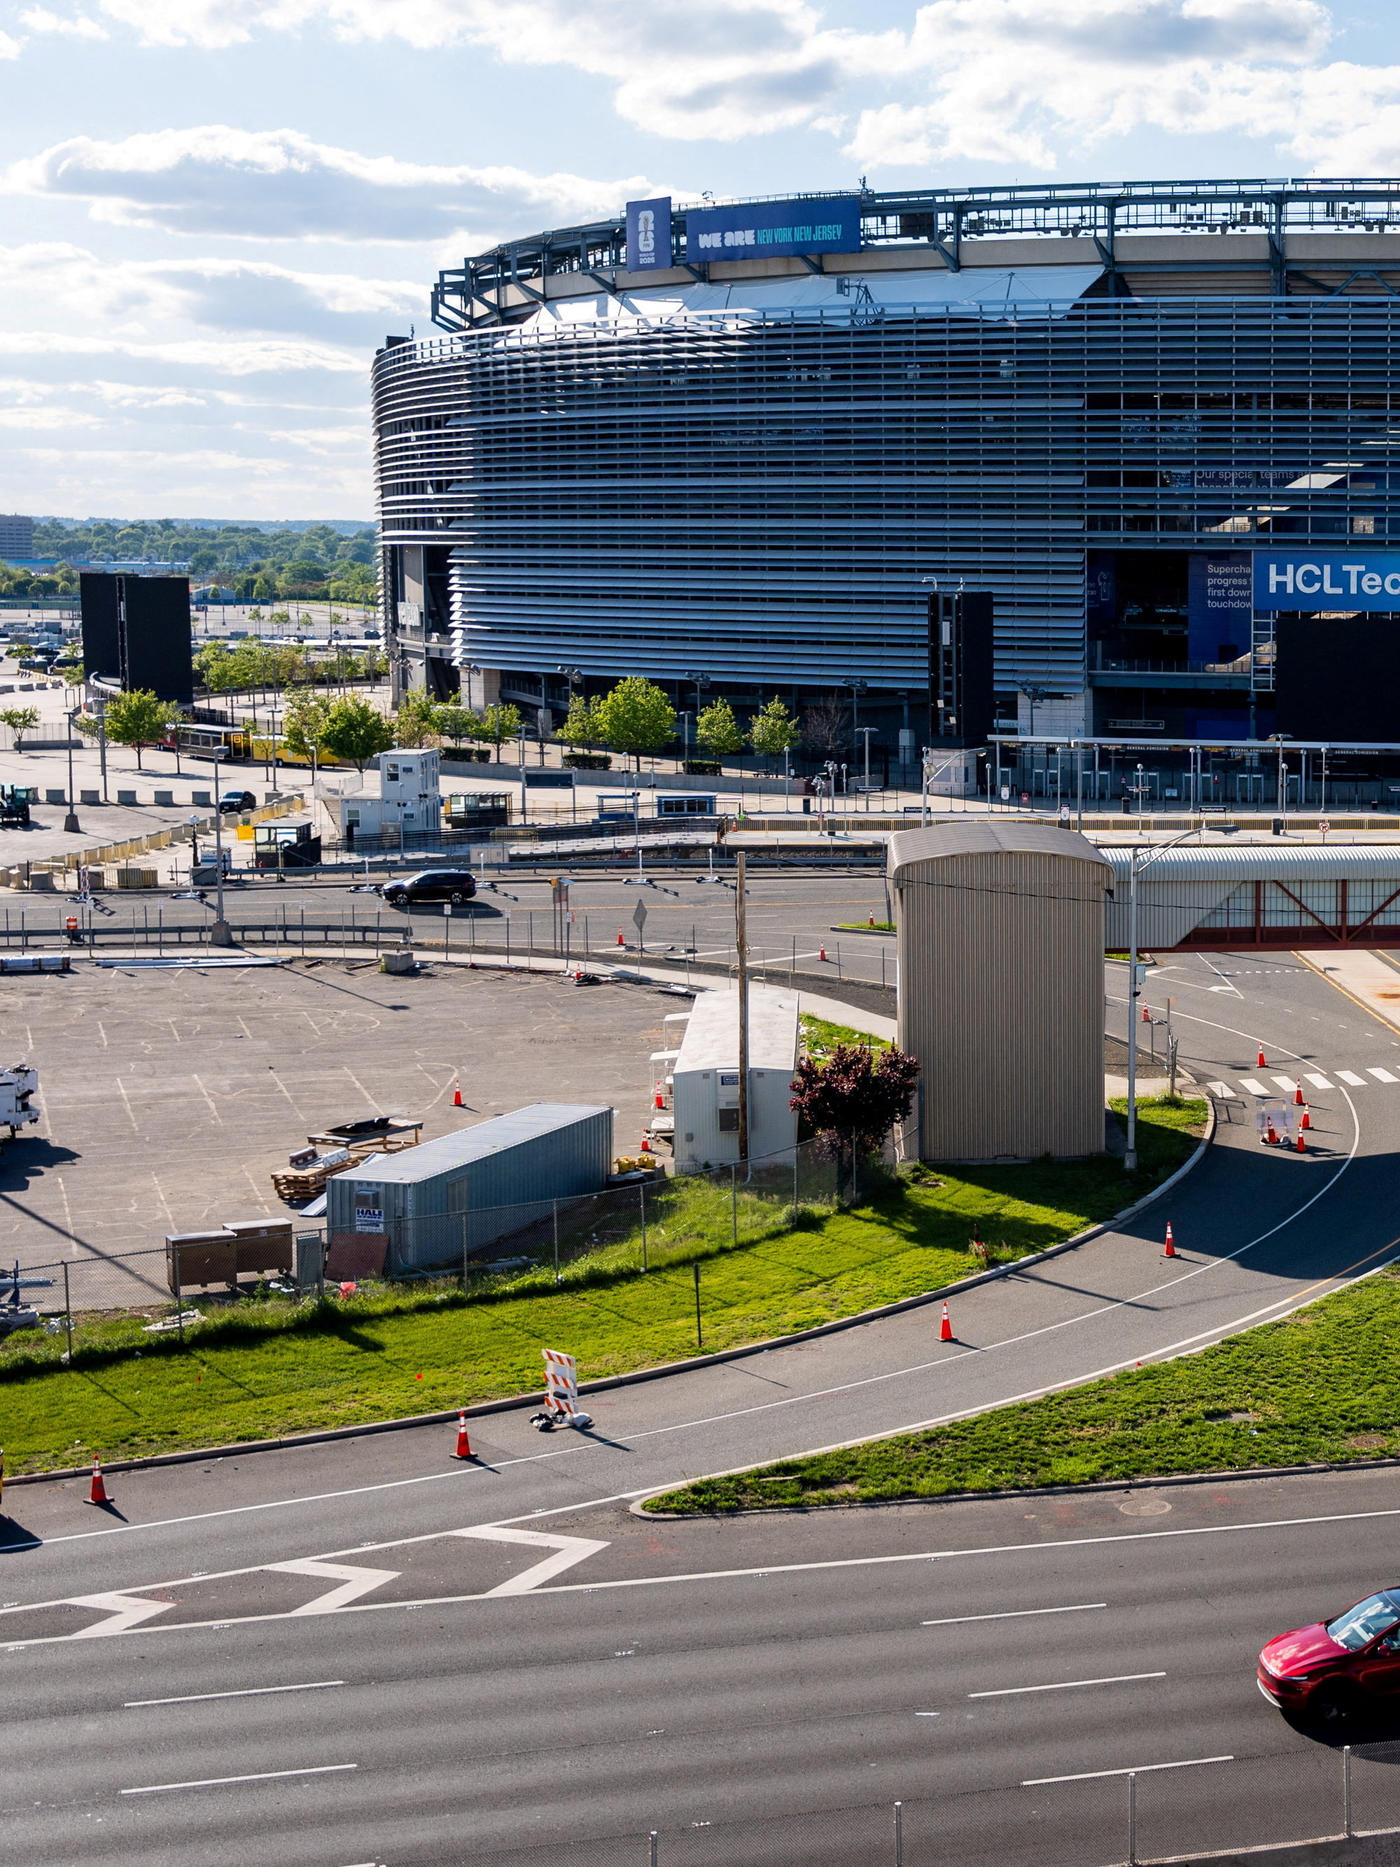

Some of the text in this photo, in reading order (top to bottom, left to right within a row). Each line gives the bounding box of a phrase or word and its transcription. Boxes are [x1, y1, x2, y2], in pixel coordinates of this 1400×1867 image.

[698, 224, 842, 249] WE ARE NEW YORK NEW JERSEY
[1218, 471, 1252, 482] specia
[1207, 577, 1248, 587] progress
[1207, 587, 1226, 597] first
